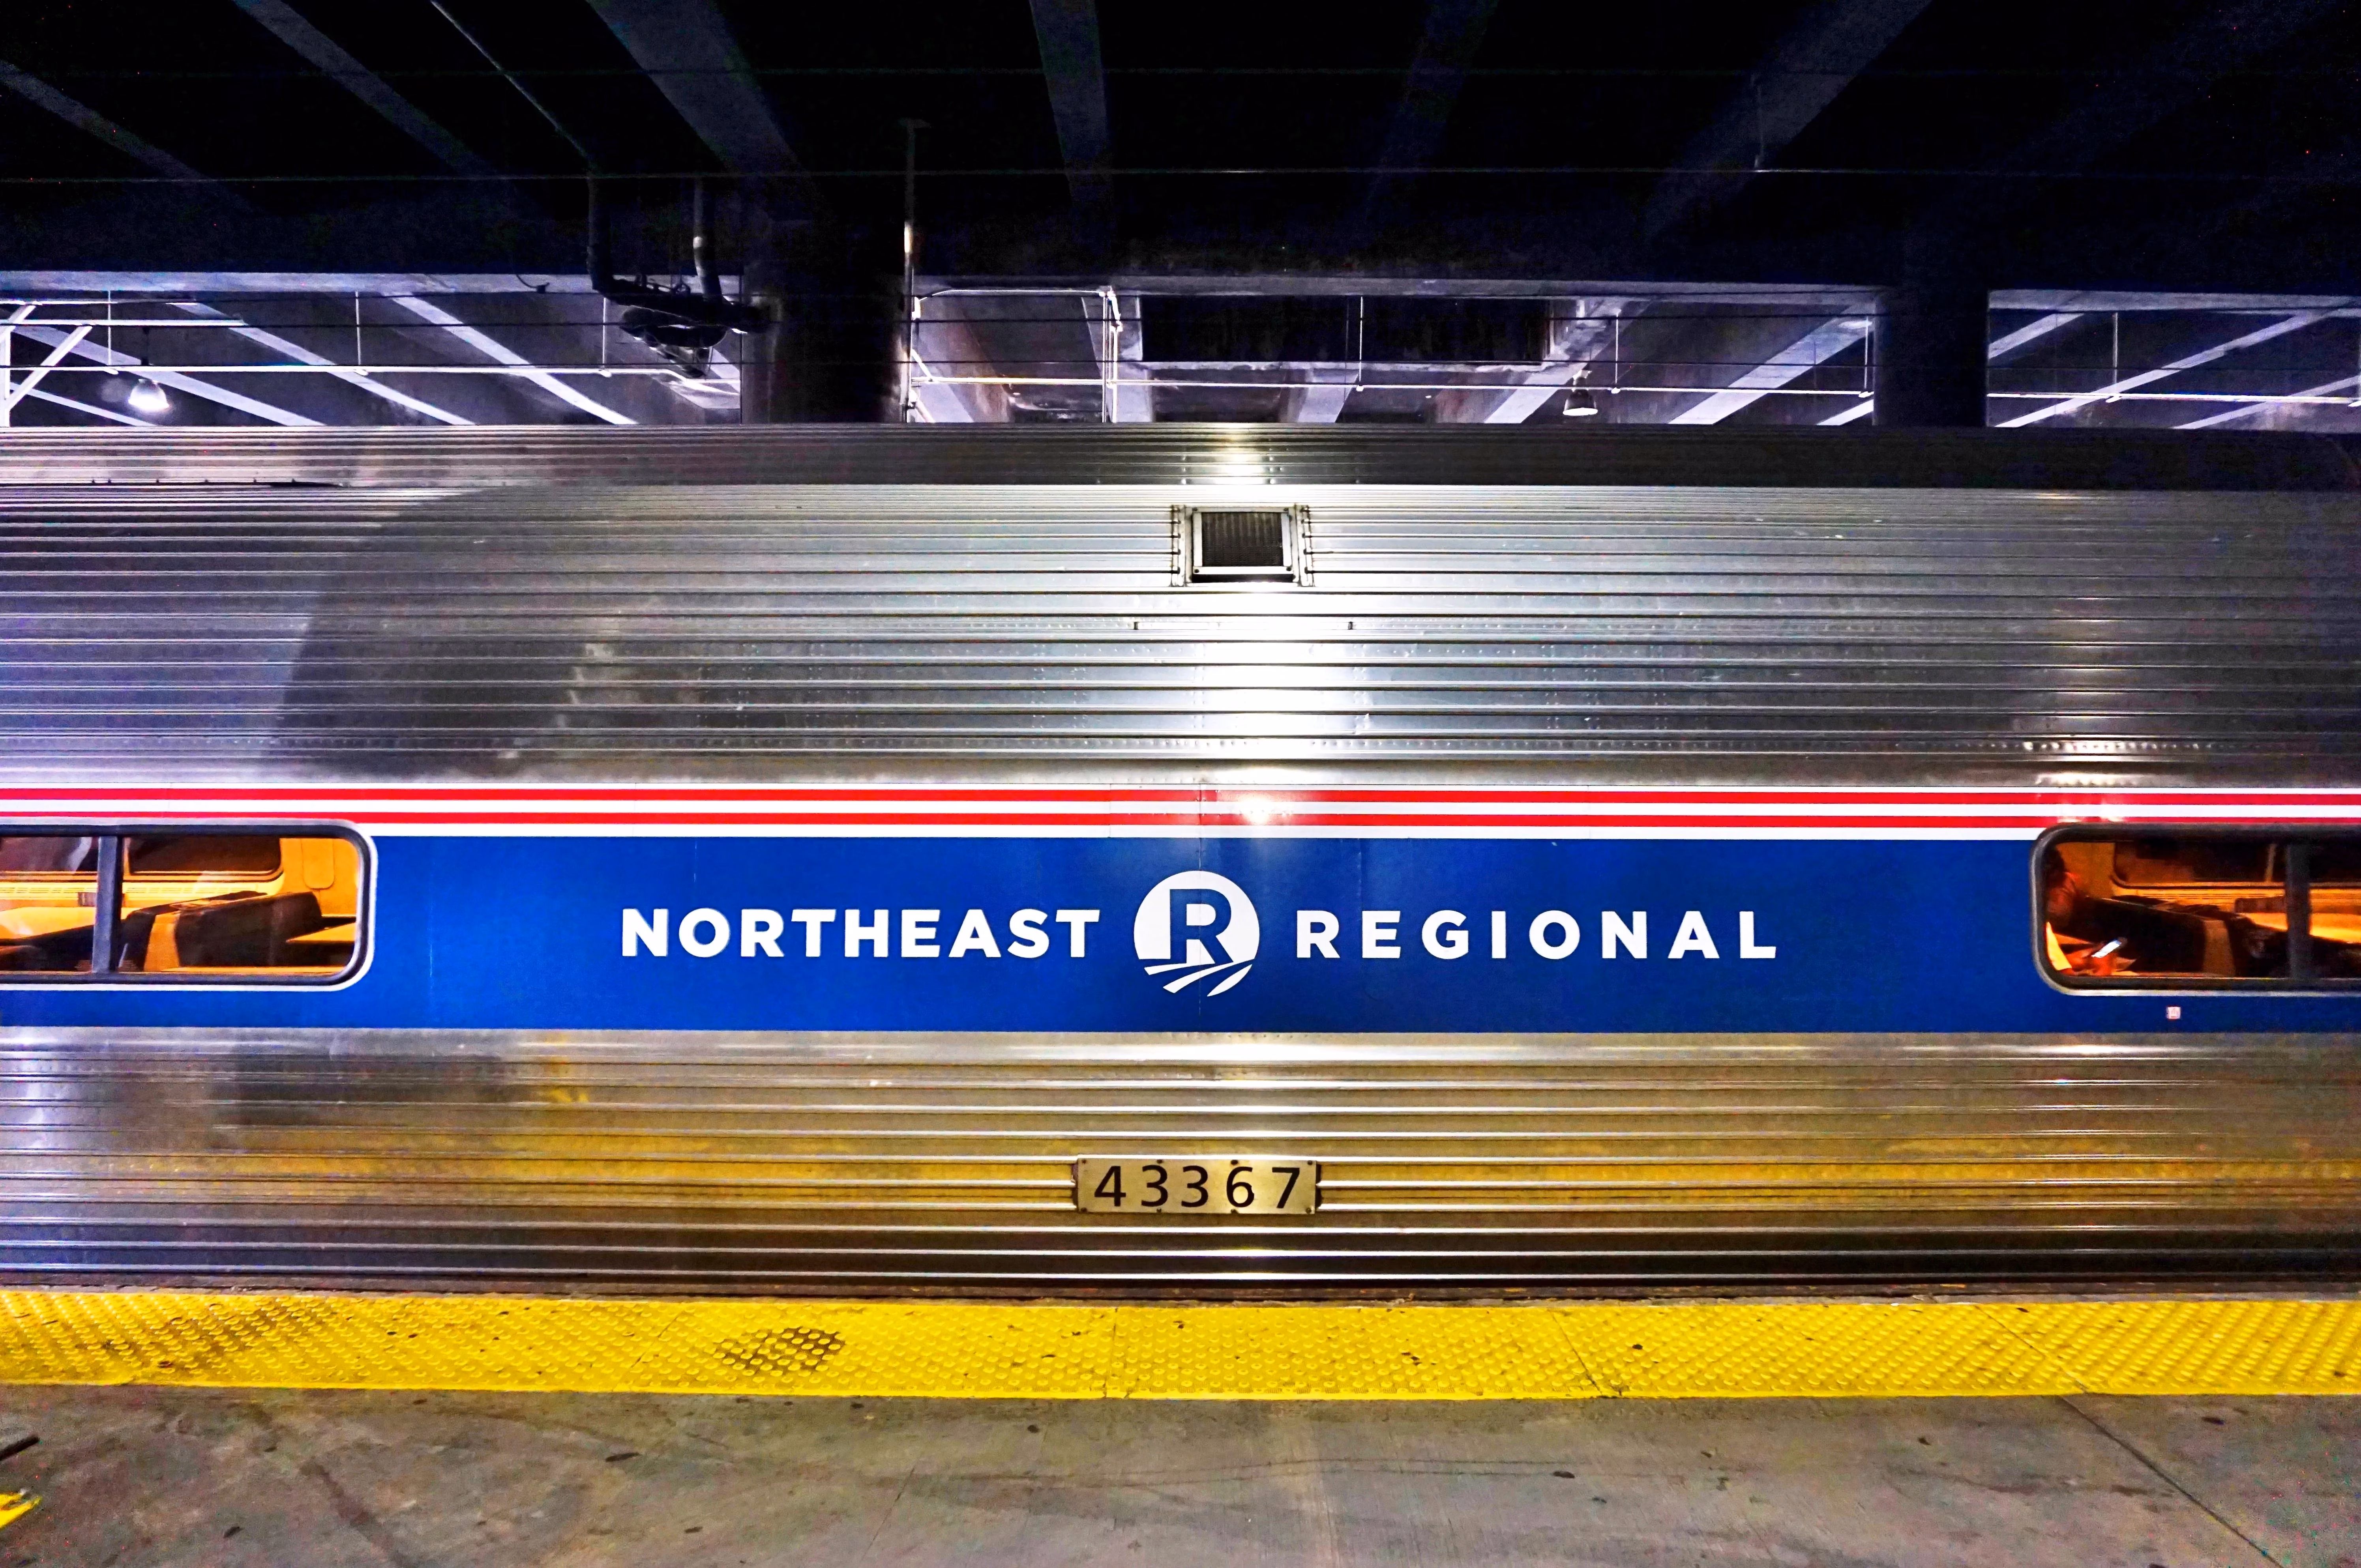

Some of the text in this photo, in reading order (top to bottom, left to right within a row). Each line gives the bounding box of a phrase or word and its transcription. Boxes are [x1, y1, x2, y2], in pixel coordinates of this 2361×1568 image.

[622, 908, 1100, 958] NORTHEAST
[1297, 910, 1776, 960] REGIONAL
[1094, 1165, 1300, 1209] 43367
